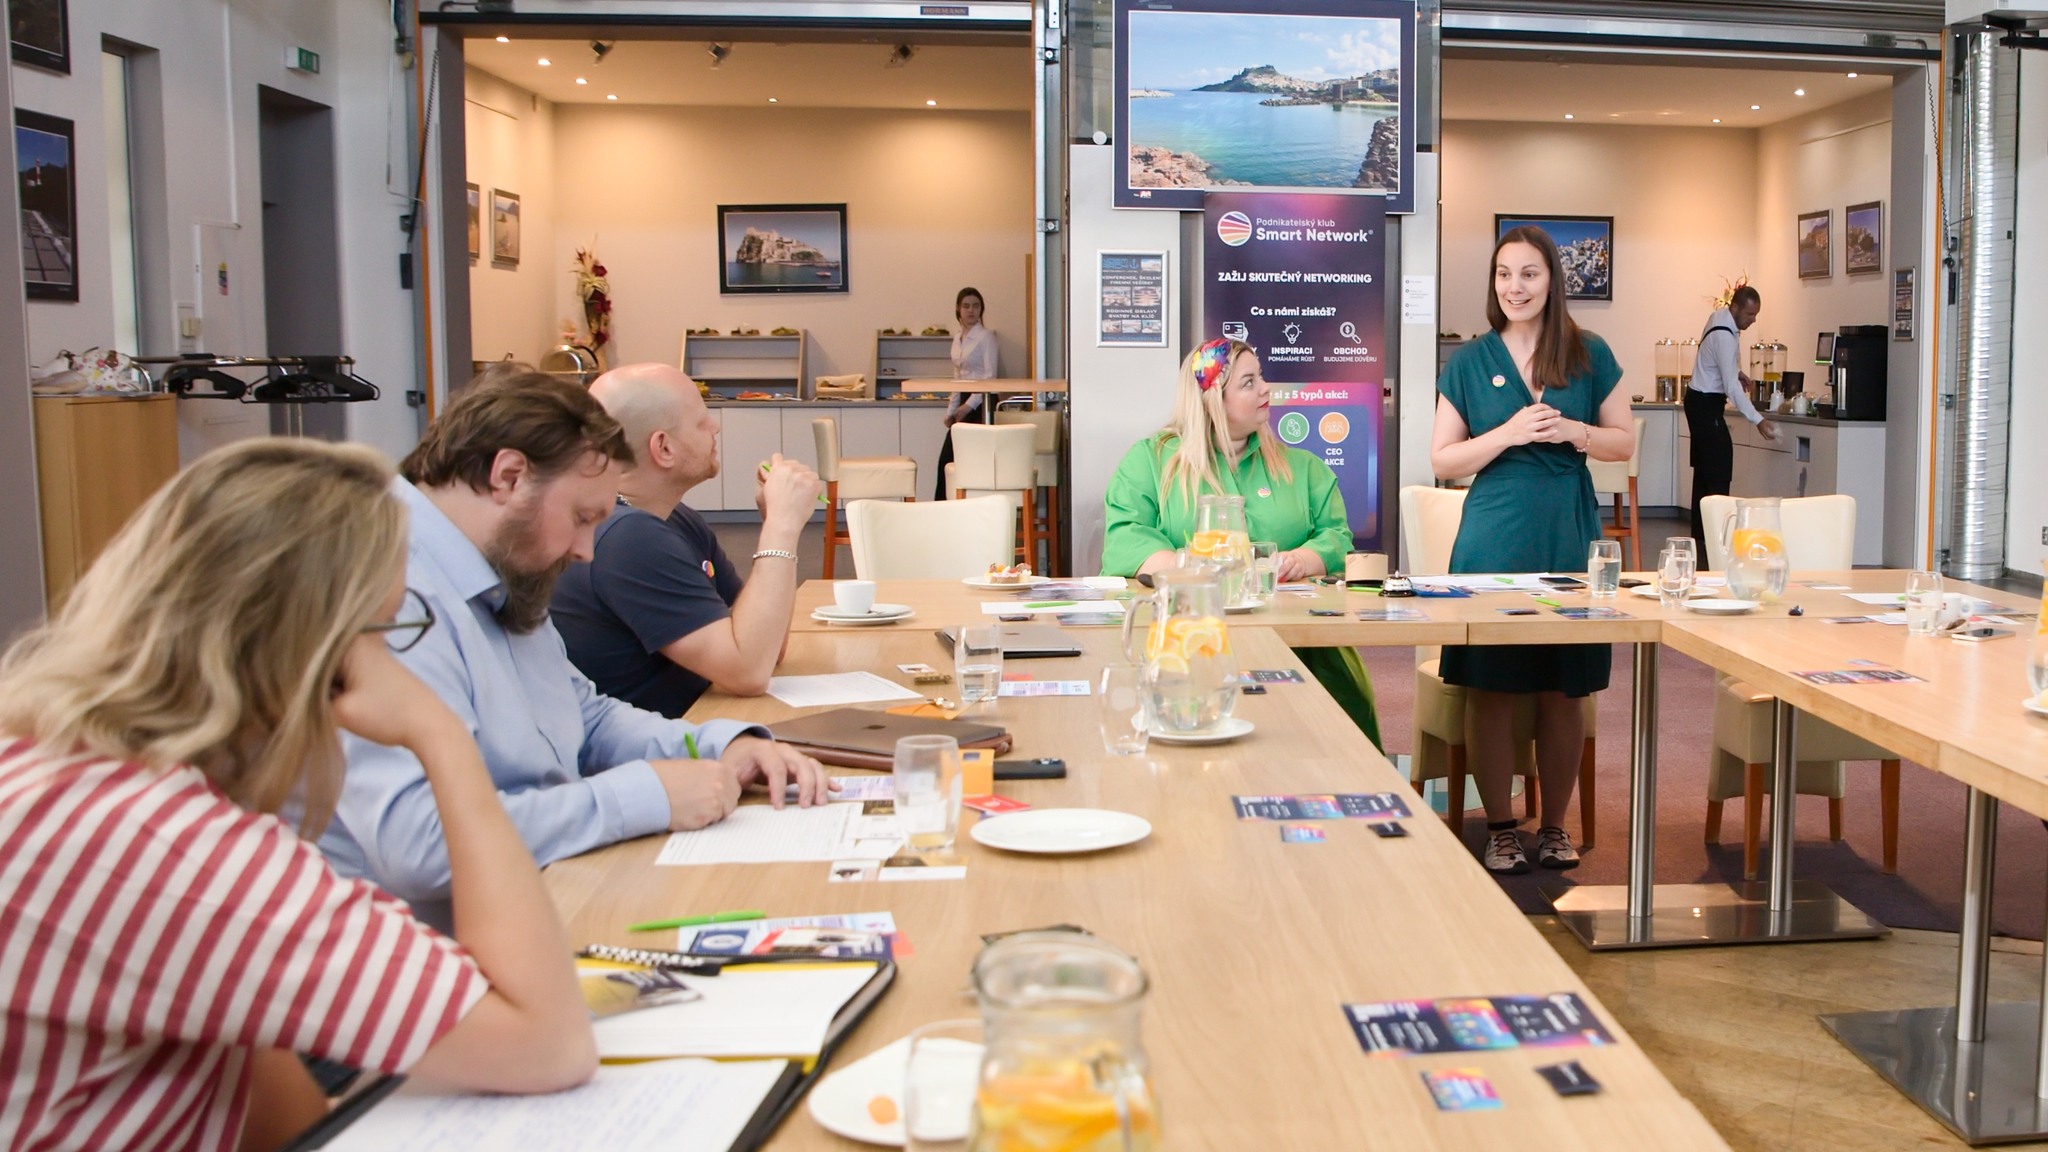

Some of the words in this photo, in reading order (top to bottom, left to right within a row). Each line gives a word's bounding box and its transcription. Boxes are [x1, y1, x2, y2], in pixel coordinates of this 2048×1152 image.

[1256, 217, 1316, 228] Podnikatelský
[1317, 218, 1336, 228] klub
[1256, 228, 1302, 241] Smart
[1218, 270, 1247, 282] ZAŽIJ
[1248, 270, 1302, 283] SKUTEČNÝ
[1304, 273, 1372, 283] NETWORKING
[1250, 306, 1266, 316] Co
[1267, 308, 1273, 316] s
[1274, 306, 1300, 316] námi
[1271, 347, 1313, 355] INSPIRACI
[1333, 347, 1368, 355] OBCHOD
[1354, 355, 1377, 363] DŮVĚRU
[1274, 390, 1283, 399] si
[1292, 390, 1299, 399] 5
[1300, 389, 1323, 401] typů
[1325, 448, 1343, 456] CEO
[1324, 458, 1344, 466] AKCE
